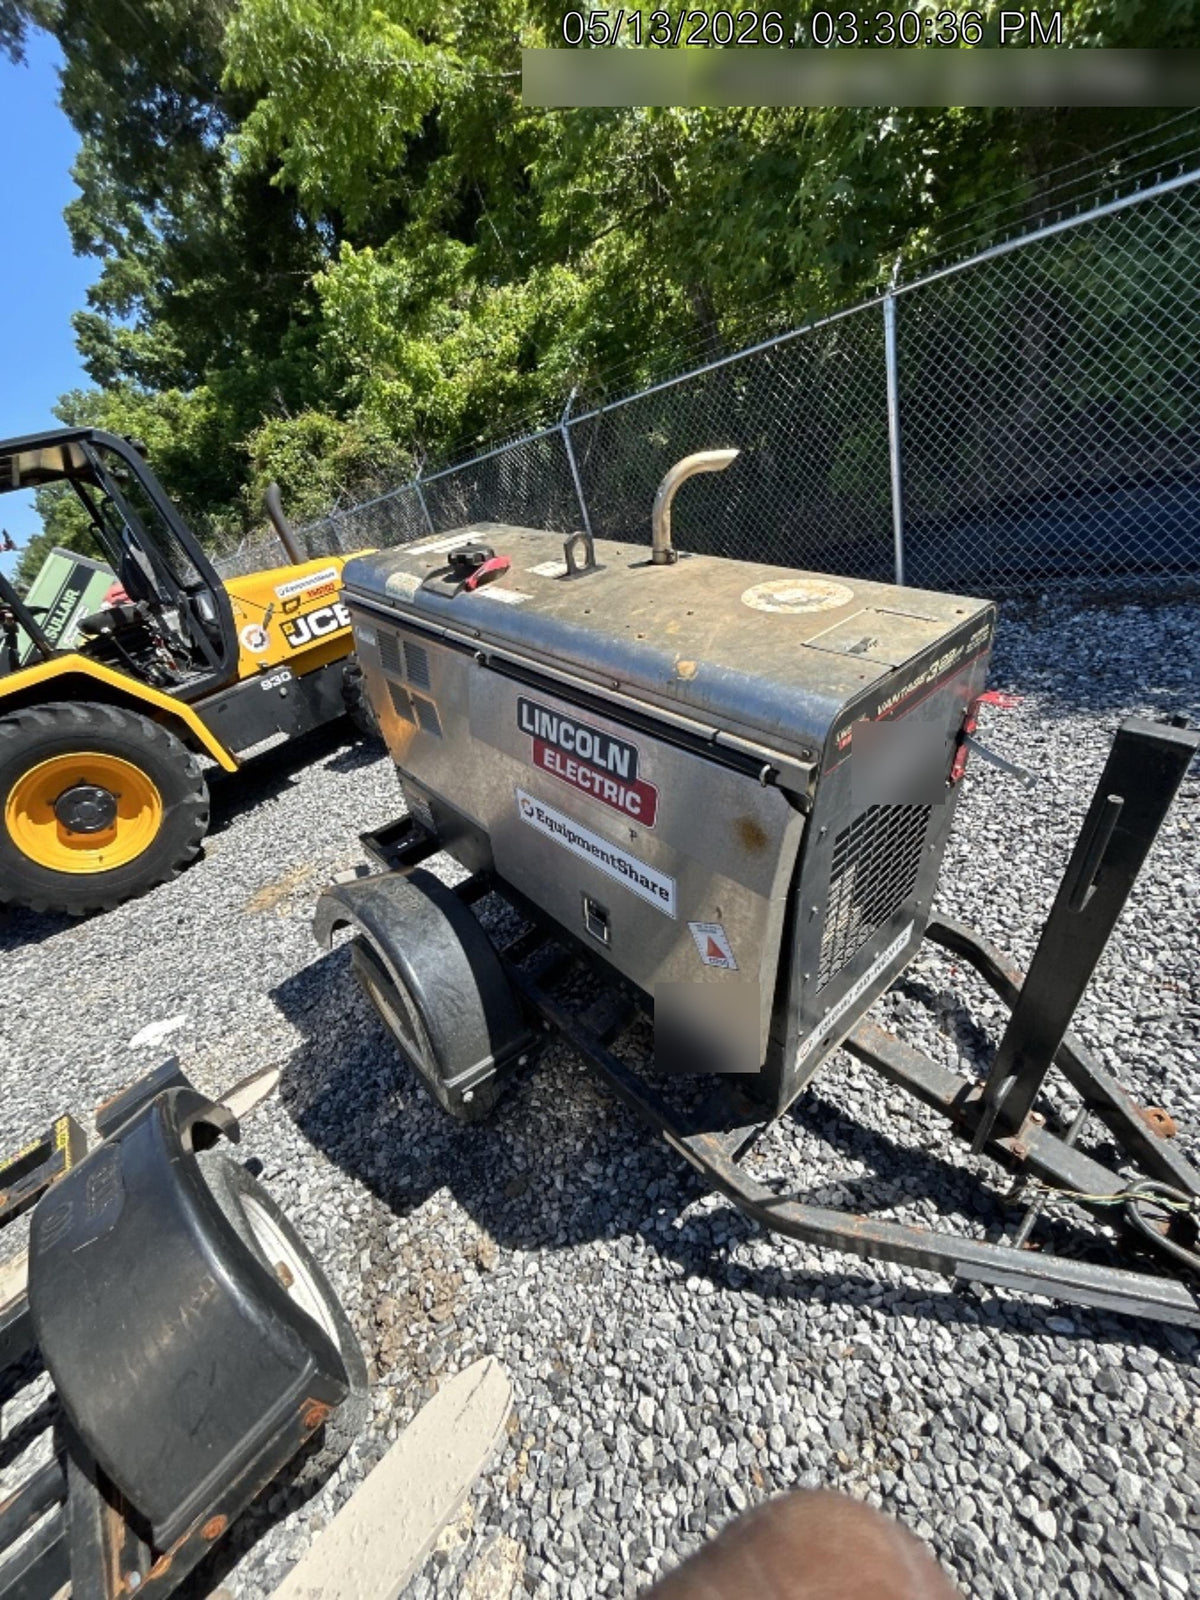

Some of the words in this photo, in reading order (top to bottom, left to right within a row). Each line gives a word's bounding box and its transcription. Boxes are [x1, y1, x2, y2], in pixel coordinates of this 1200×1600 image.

[44, 589, 80, 640] SULLAIR
[260, 671, 293, 691] 930
[521, 703, 631, 778] LINCOLN
[543, 748, 642, 816] ELECTRIC
[534, 807, 670, 902] EquipmentShare
